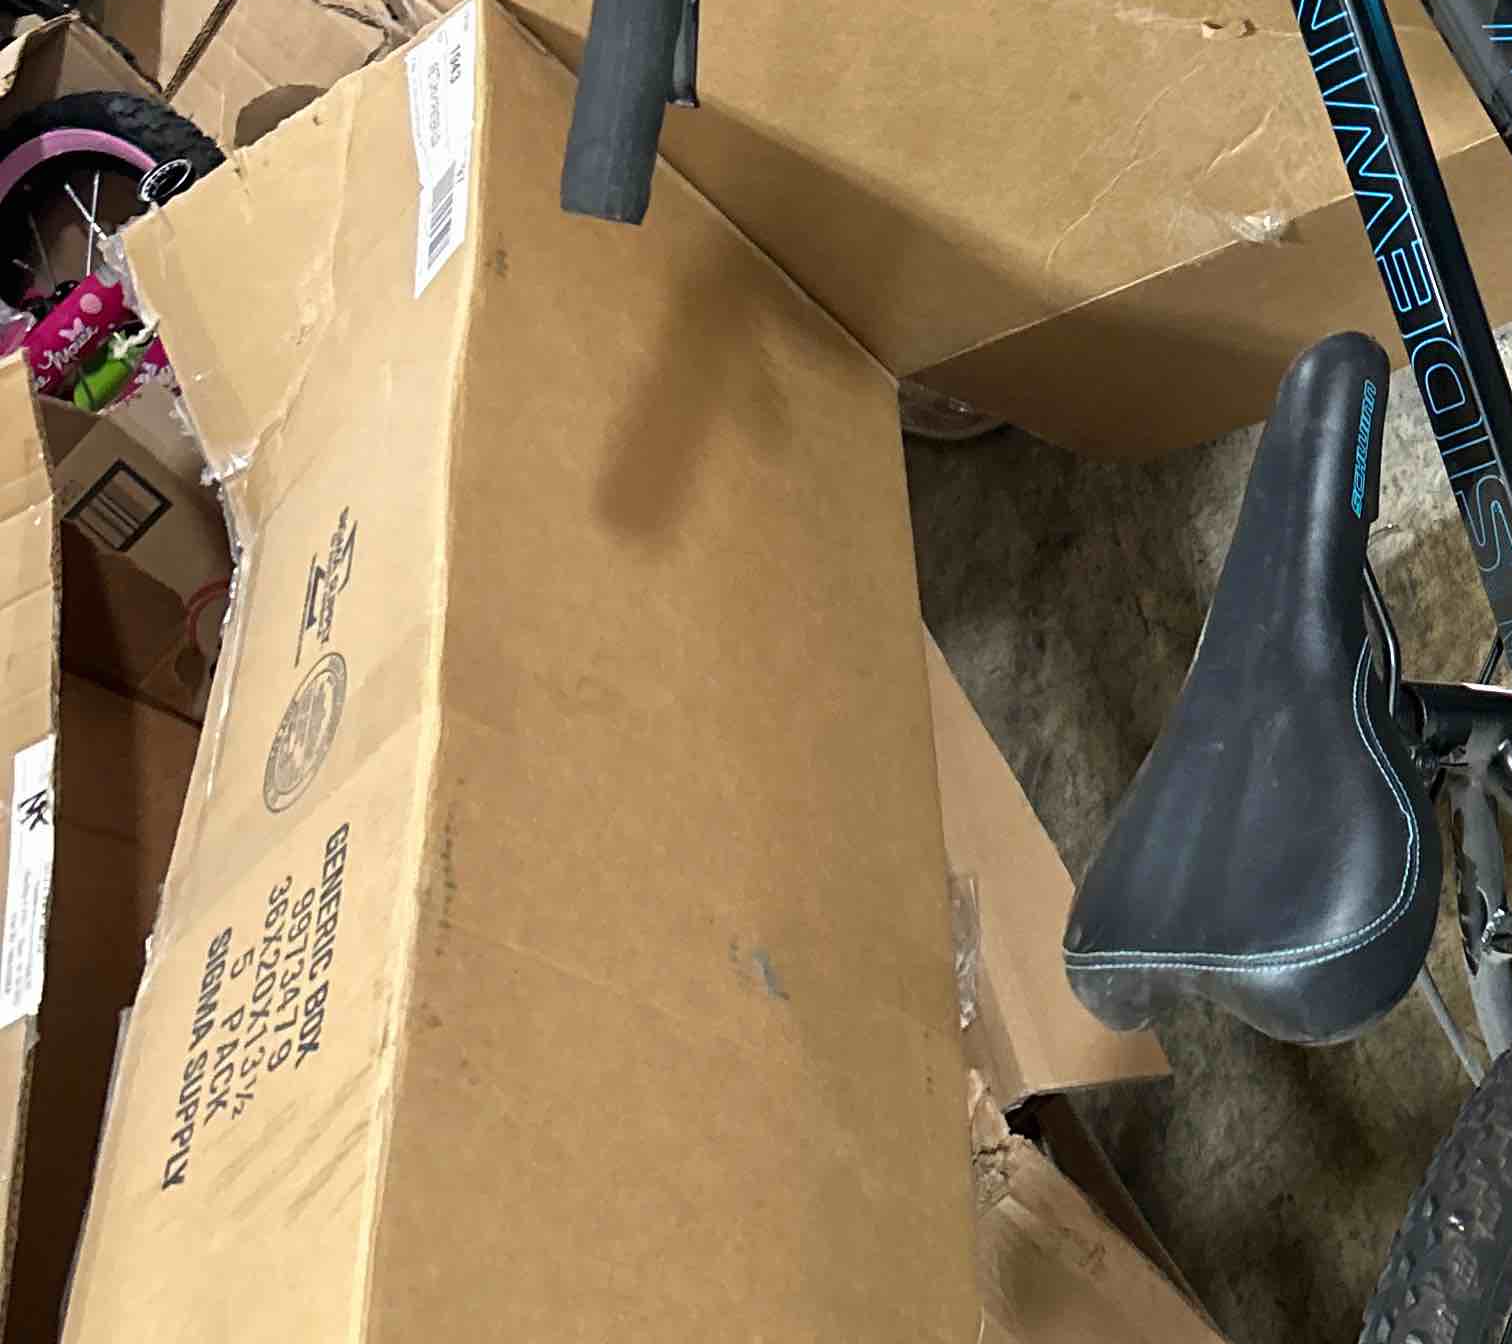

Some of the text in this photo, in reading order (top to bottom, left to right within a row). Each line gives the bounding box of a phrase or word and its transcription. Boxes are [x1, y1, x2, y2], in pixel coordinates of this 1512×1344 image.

[1352, 379, 1377, 520] SCHWINN
[229, 947, 255, 981] 5
[295, 821, 350, 1070] GENERIC BOX
[161, 926, 233, 1191] SIGMA SUPPLY
